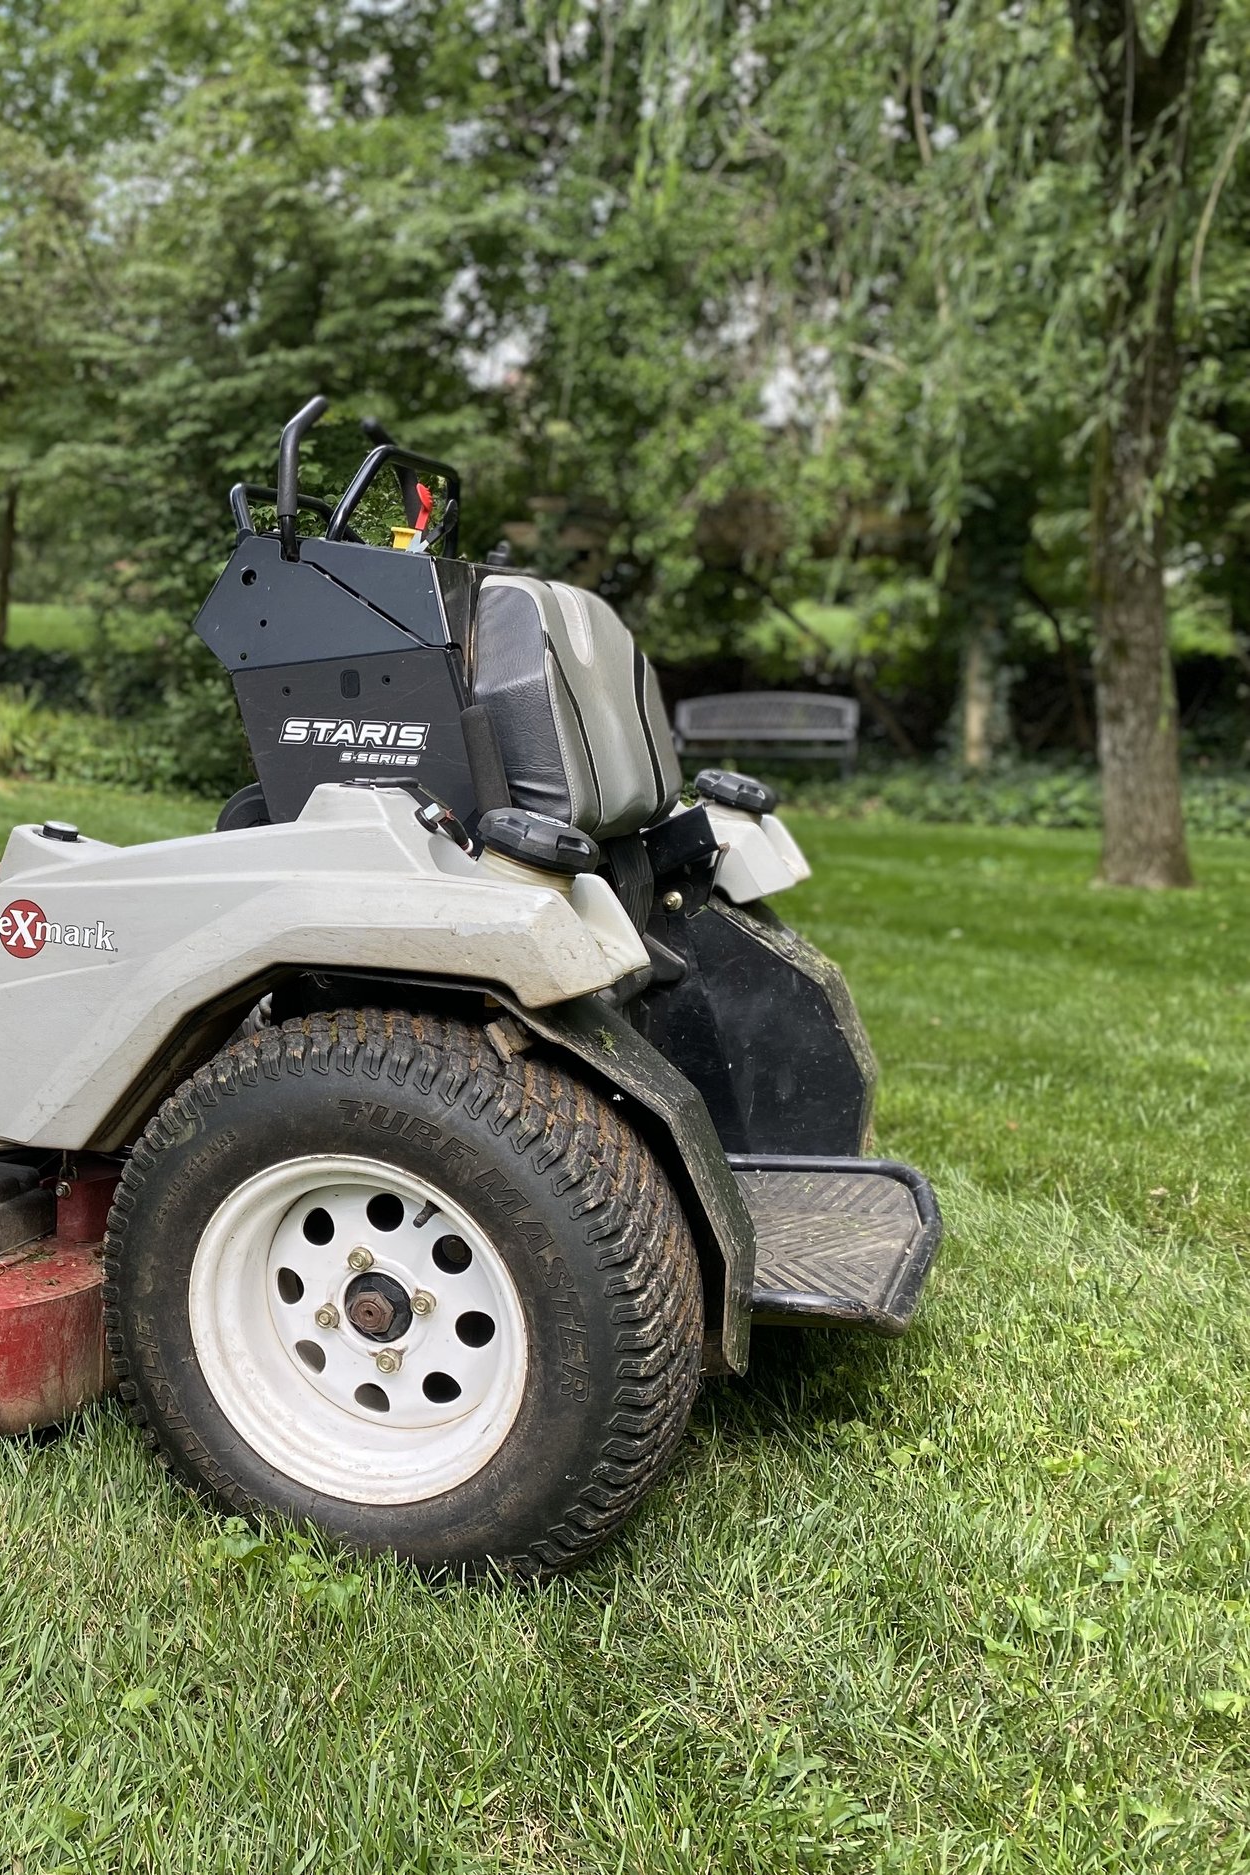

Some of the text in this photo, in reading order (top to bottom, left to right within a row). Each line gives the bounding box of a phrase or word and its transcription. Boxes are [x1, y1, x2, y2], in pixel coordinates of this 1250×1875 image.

[279, 717, 430, 750] STARIS
[339, 751, 420, 766] S-SERIES
[338, 1099, 479, 1161] TURF
[474, 1168, 591, 1403] MASTER
